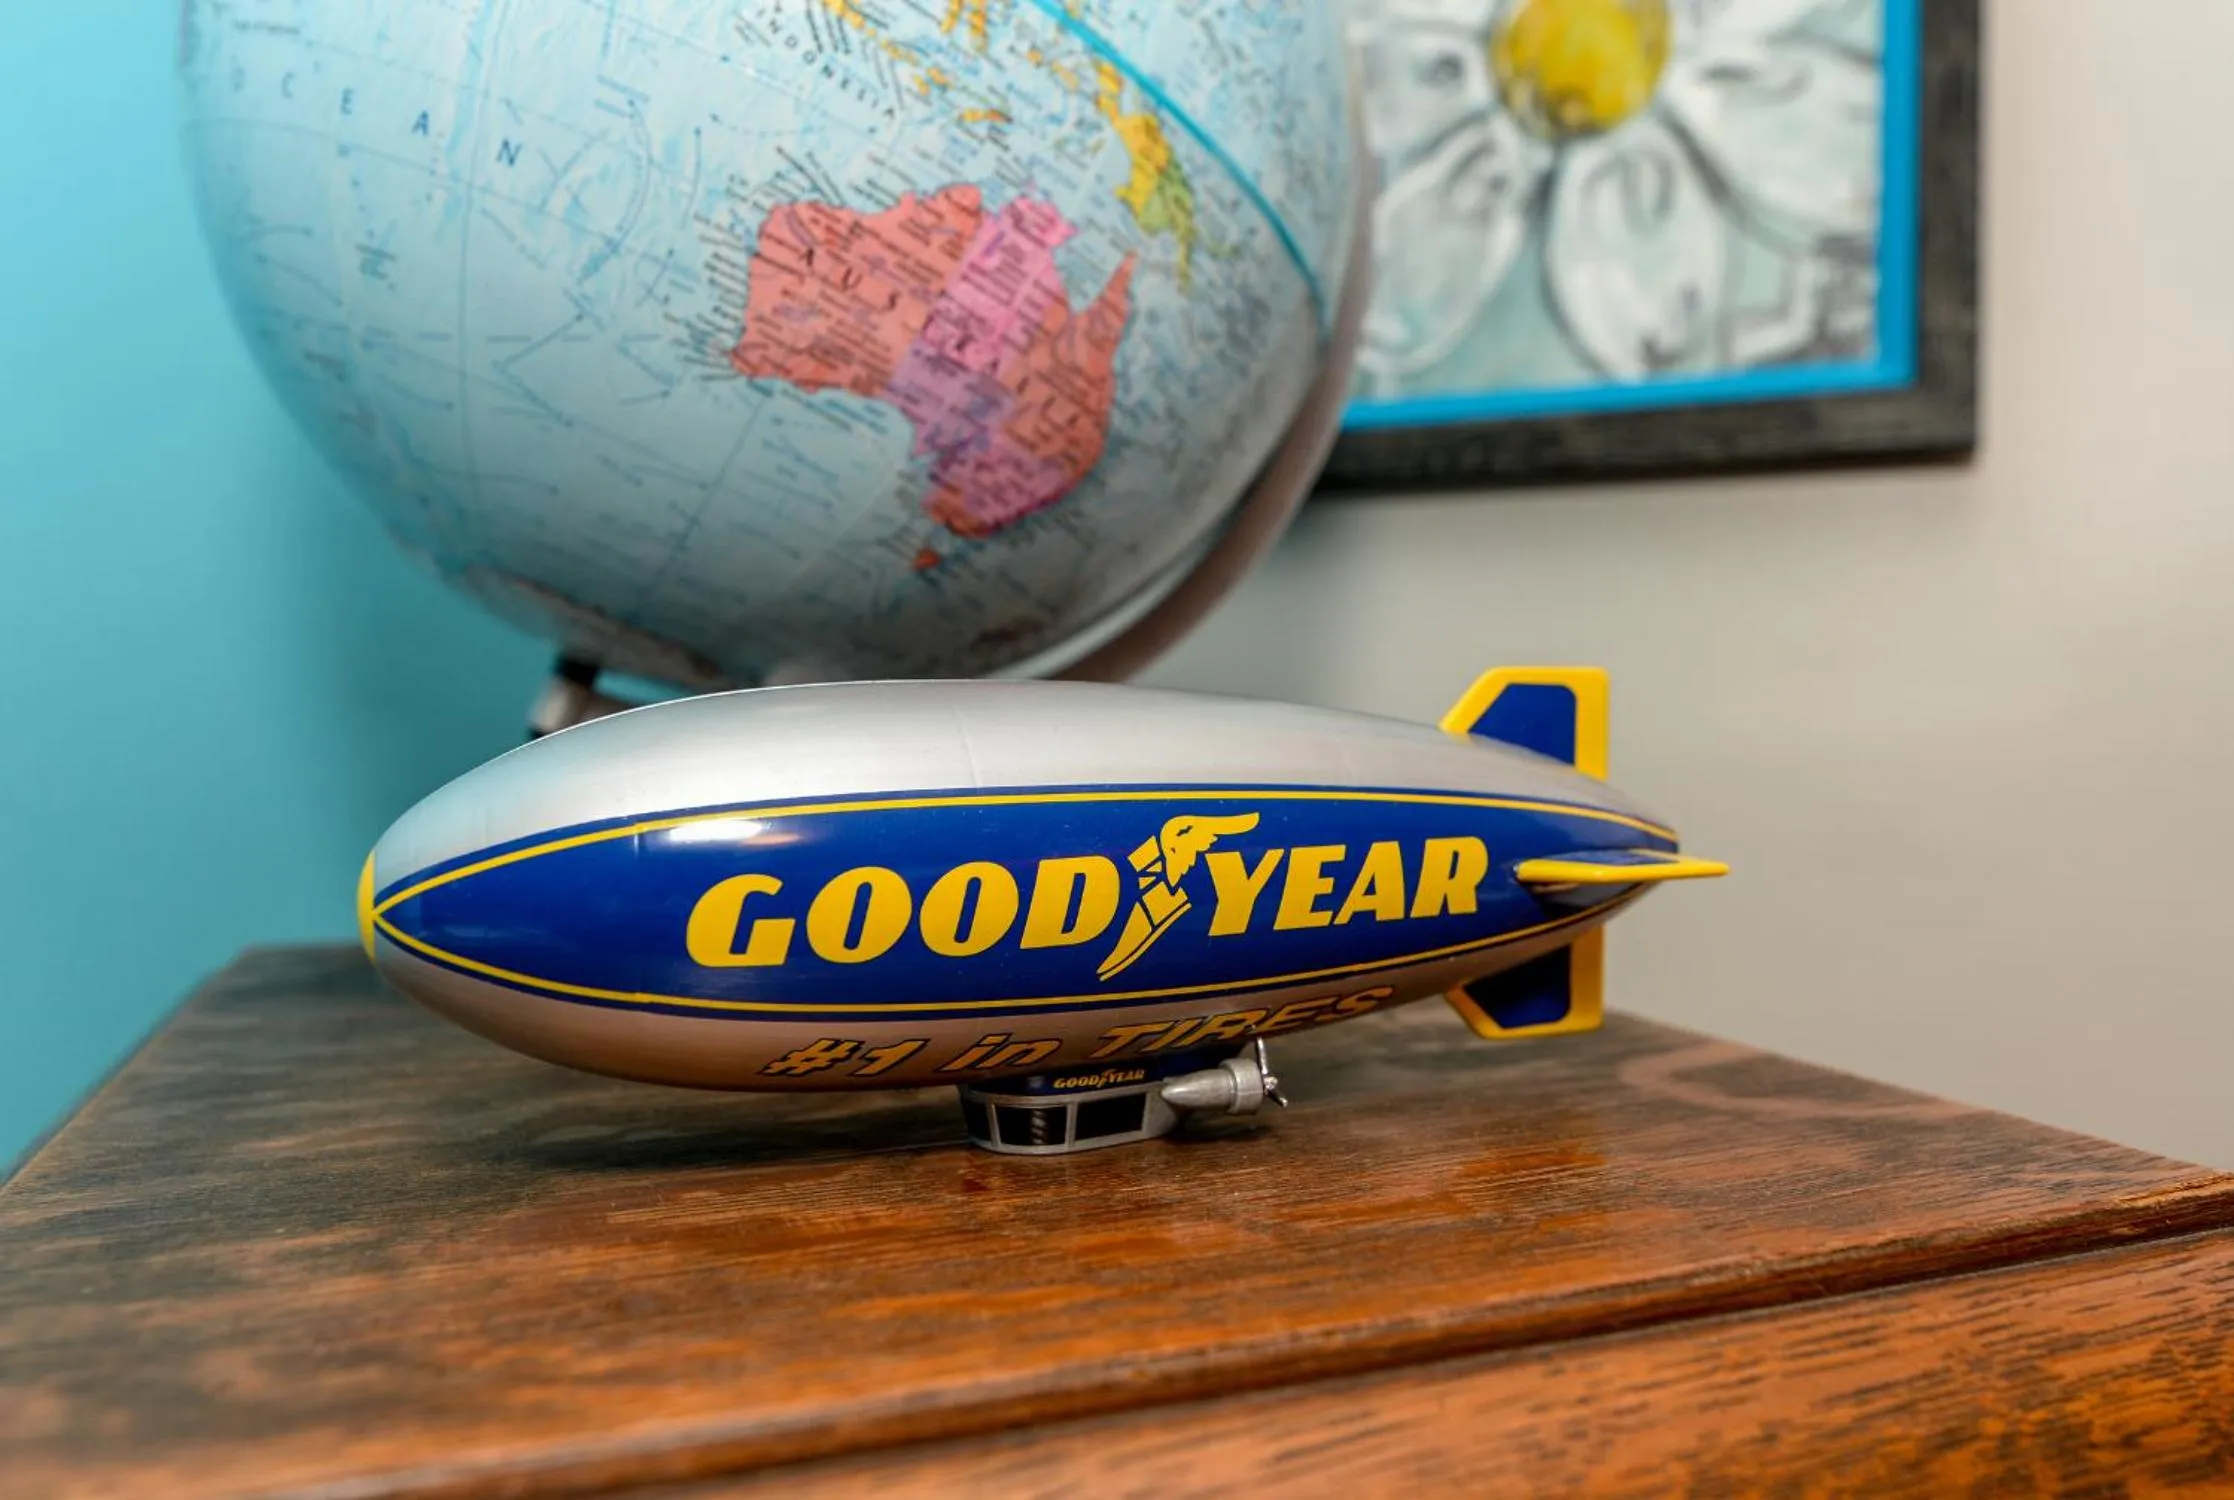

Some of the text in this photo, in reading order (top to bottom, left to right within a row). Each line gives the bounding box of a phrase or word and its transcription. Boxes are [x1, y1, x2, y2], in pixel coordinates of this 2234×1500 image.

[757, 986, 1396, 1076] #1 in TIRES
